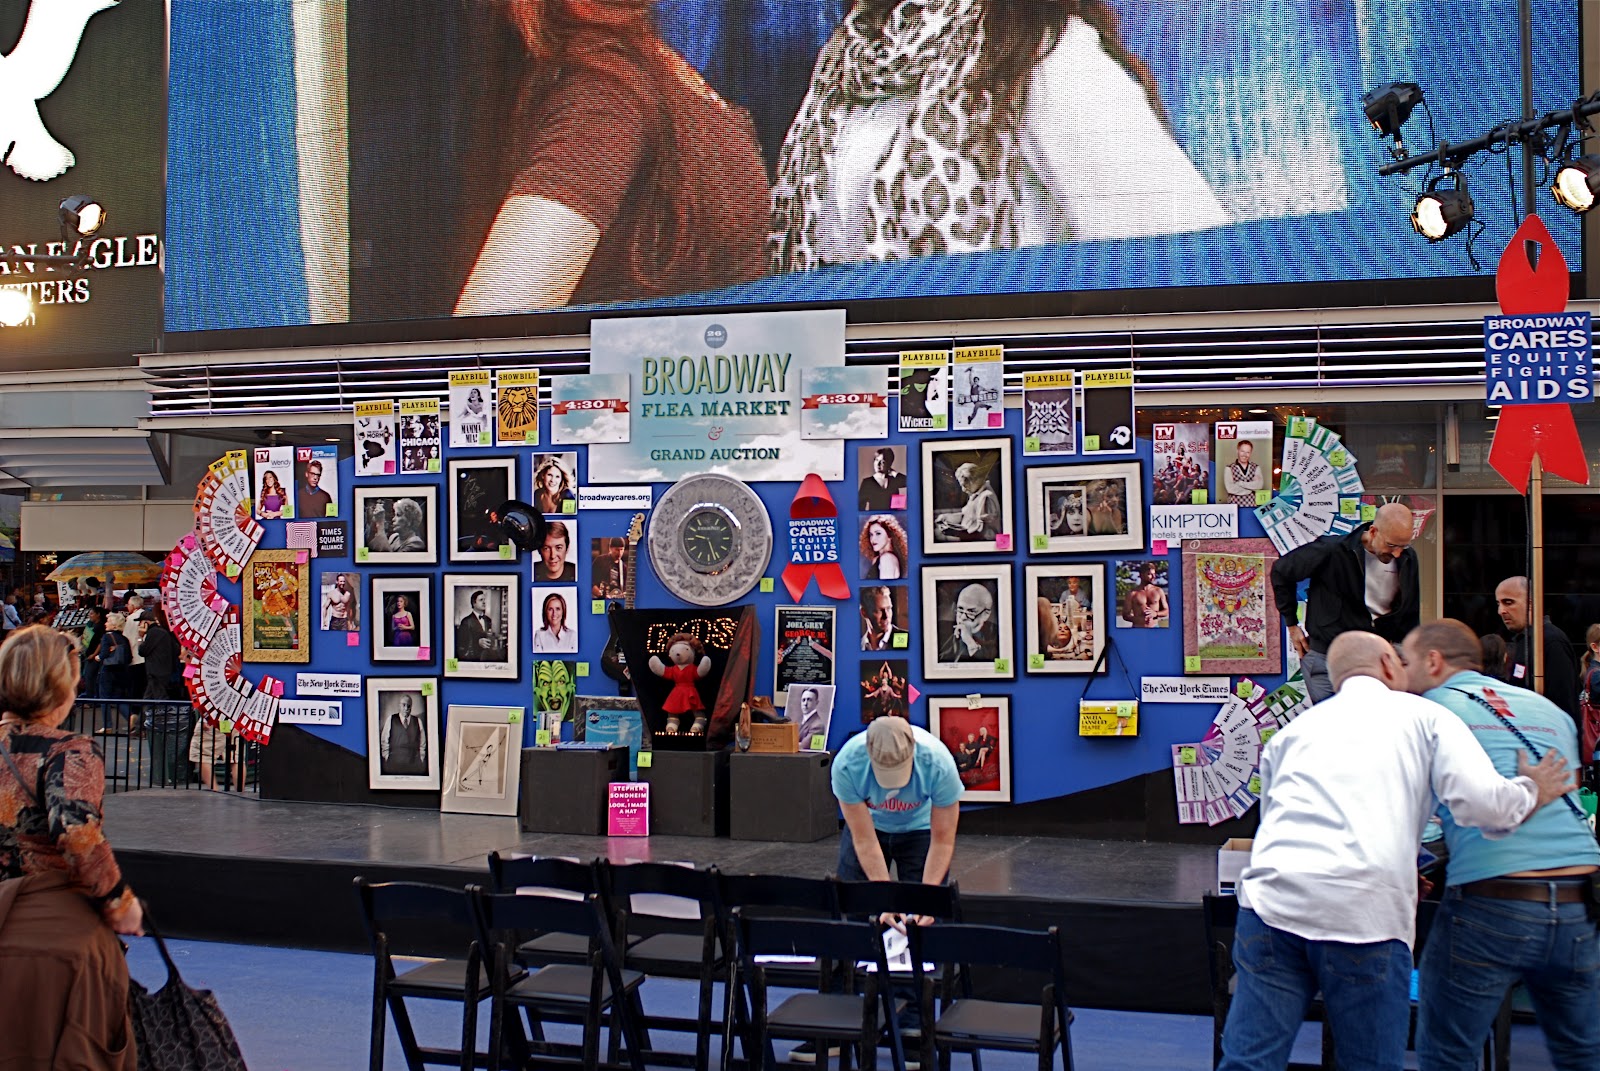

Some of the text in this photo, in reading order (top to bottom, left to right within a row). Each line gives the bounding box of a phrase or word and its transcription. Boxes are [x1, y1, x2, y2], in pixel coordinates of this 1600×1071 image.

[1488, 316, 1586, 330] BROADWAY
[1488, 330, 1588, 350] CARES
[956, 349, 1000, 358] PLAYBILL
[1491, 351, 1586, 364] EQUITY
[642, 353, 792, 396] BROADWAY
[1491, 365, 1587, 378] FIGHTS
[1026, 375, 1072, 383] PLAYBILL
[1489, 378, 1590, 400] AIDS
[565, 399, 605, 410] 4:30
[816, 394, 873, 404] 4:30 PM
[642, 400, 790, 418] FLEA MARKET
[1027, 398, 1070, 420] ROCK
[708, 426, 724, 440] &
[1027, 418, 1070, 436] AGES
[401, 438, 440, 446] CHICAGO
[1154, 441, 1209, 453] SMASH
[650, 448, 780, 461] GRAND AUCTION
[271, 459, 291, 468] Wendy
[1298, 456, 1307, 467] THE
[1298, 450, 1316, 477] NARCHIST
[1305, 464, 1328, 486] COUNTS
[1306, 466, 1320, 479] DEAD
[1308, 483, 1335, 497] COUNTS
[1311, 481, 1327, 490] DEAD
[221, 494, 231, 505] ONCE
[579, 493, 650, 502] broadwaycares.org
[217, 506, 228, 515] ONCE
[1152, 514, 1231, 528] KIMPTON
[1303, 513, 1326, 524] MOTOWN
[790, 526, 836, 537] CARES
[319, 536, 344, 544] SQUARE
[792, 550, 838, 562] AIDS
[785, 630, 815, 638] GEORGE
[298, 679, 309, 687] The
[324, 680, 339, 689] York
[340, 680, 359, 688] Times
[1143, 683, 1229, 695] The New York Times
[280, 708, 326, 716] UNITED
[1223, 703, 1238, 723] MATILDA
[1229, 717, 1248, 734] MATILDA
[1226, 762, 1242, 773] GRACE
[1216, 771, 1231, 786] GRACE
